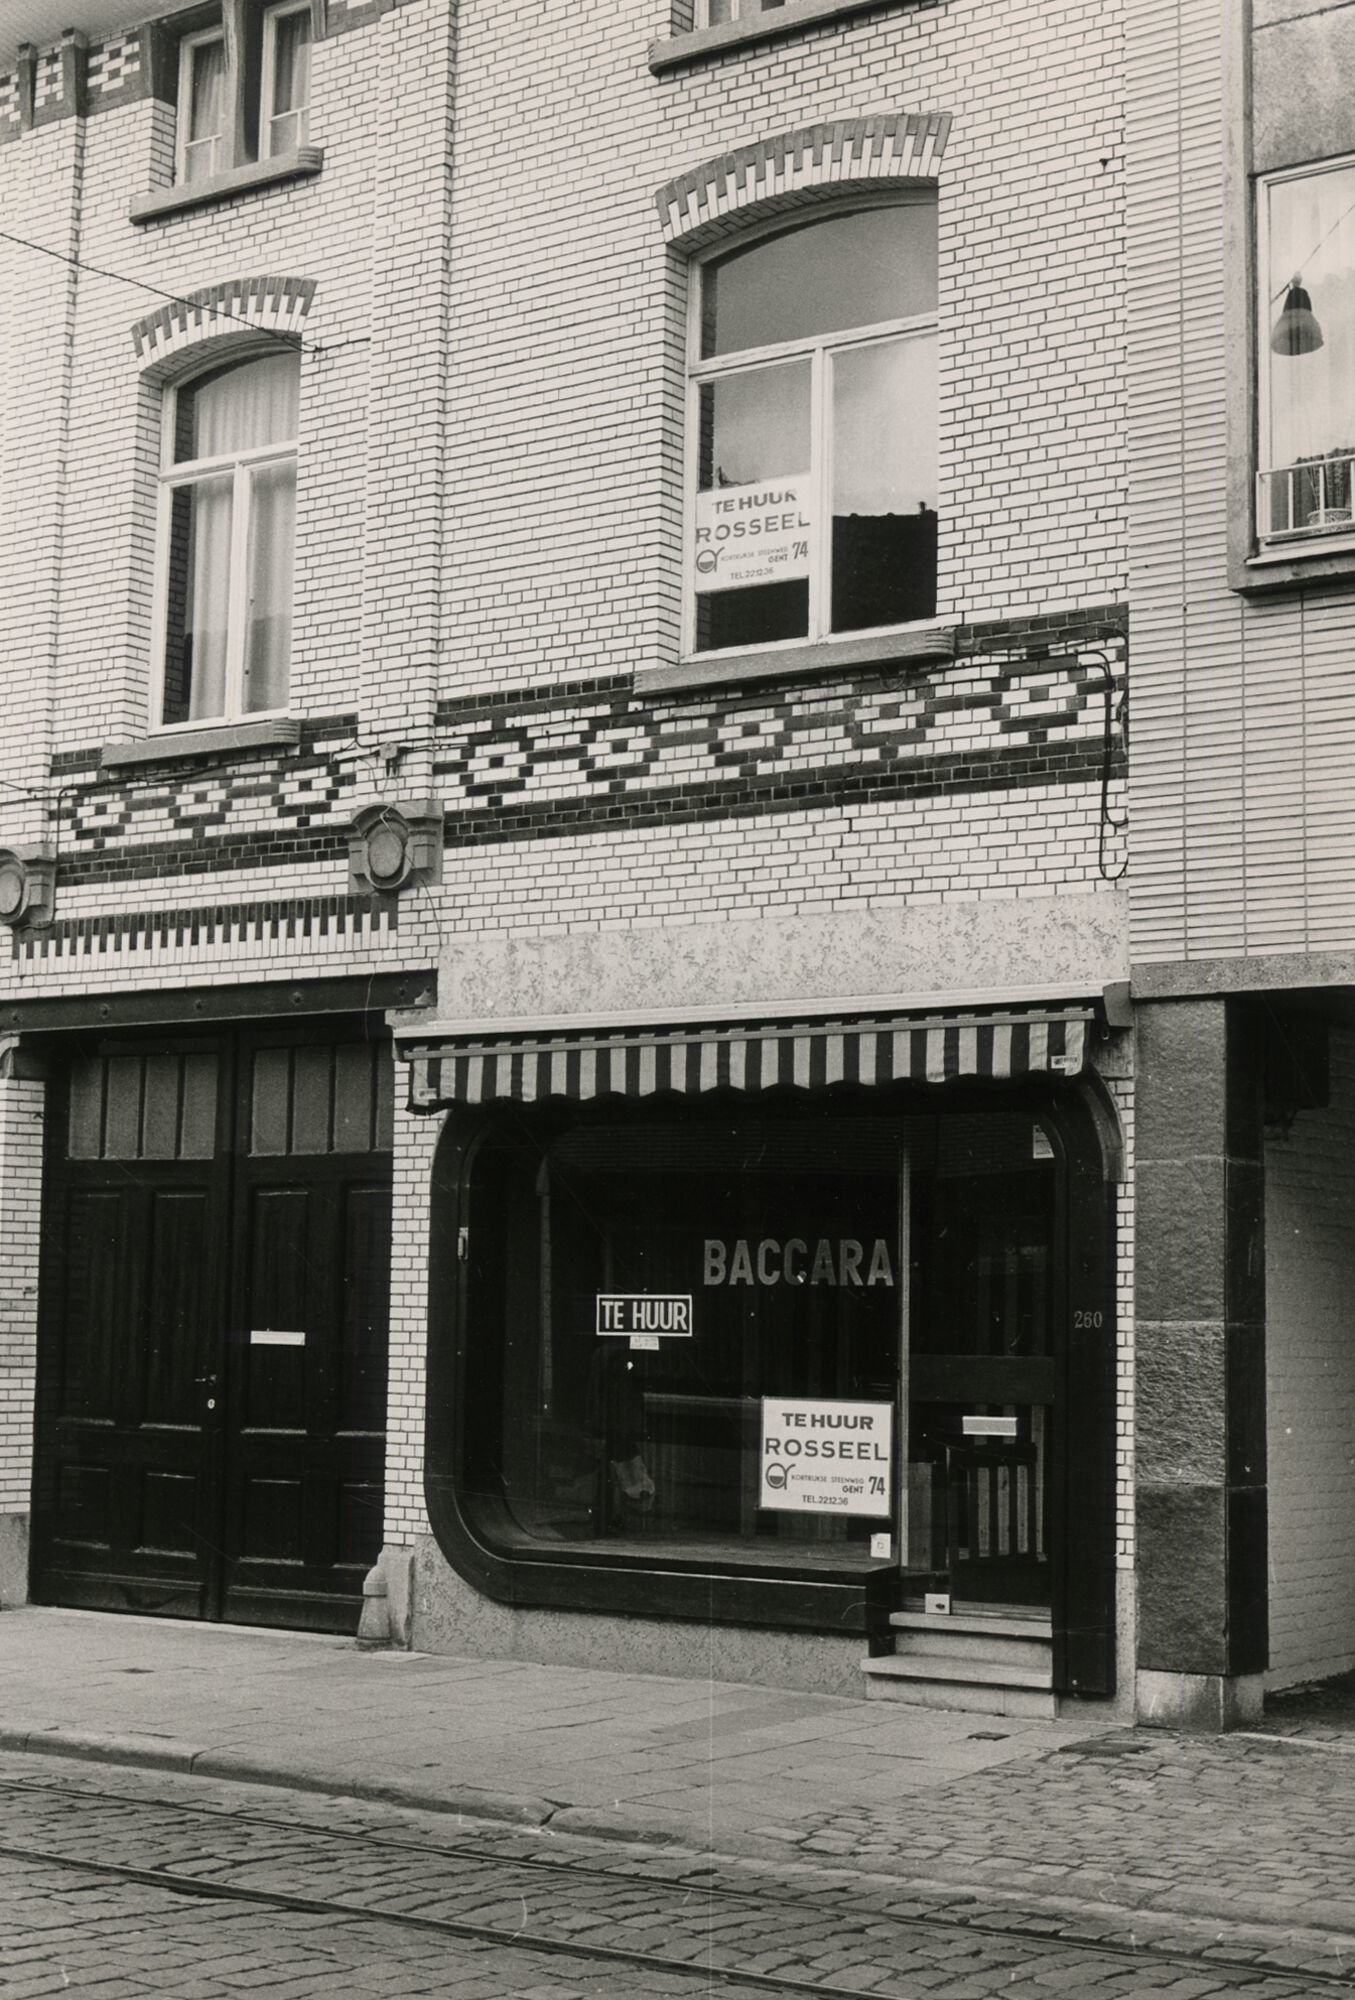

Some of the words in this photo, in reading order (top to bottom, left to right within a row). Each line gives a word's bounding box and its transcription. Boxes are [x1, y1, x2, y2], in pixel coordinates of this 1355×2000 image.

[713, 499, 735, 514] TE
[739, 489, 797, 510] HUUR
[696, 512, 810, 543] ROSSEEL
[768, 553, 788, 563] GENT
[703, 1239, 894, 1286] BACCARA
[601, 1301, 624, 1330] TE
[632, 1301, 688, 1330] HUUR
[1073, 1310, 1103, 1329] 260
[782, 1412, 807, 1427] TE
[810, 1414, 874, 1430] HUUR
[765, 1438, 888, 1461] ROSSEEL
[842, 1485, 864, 1494] GENT
[868, 1476, 886, 1495] 74
